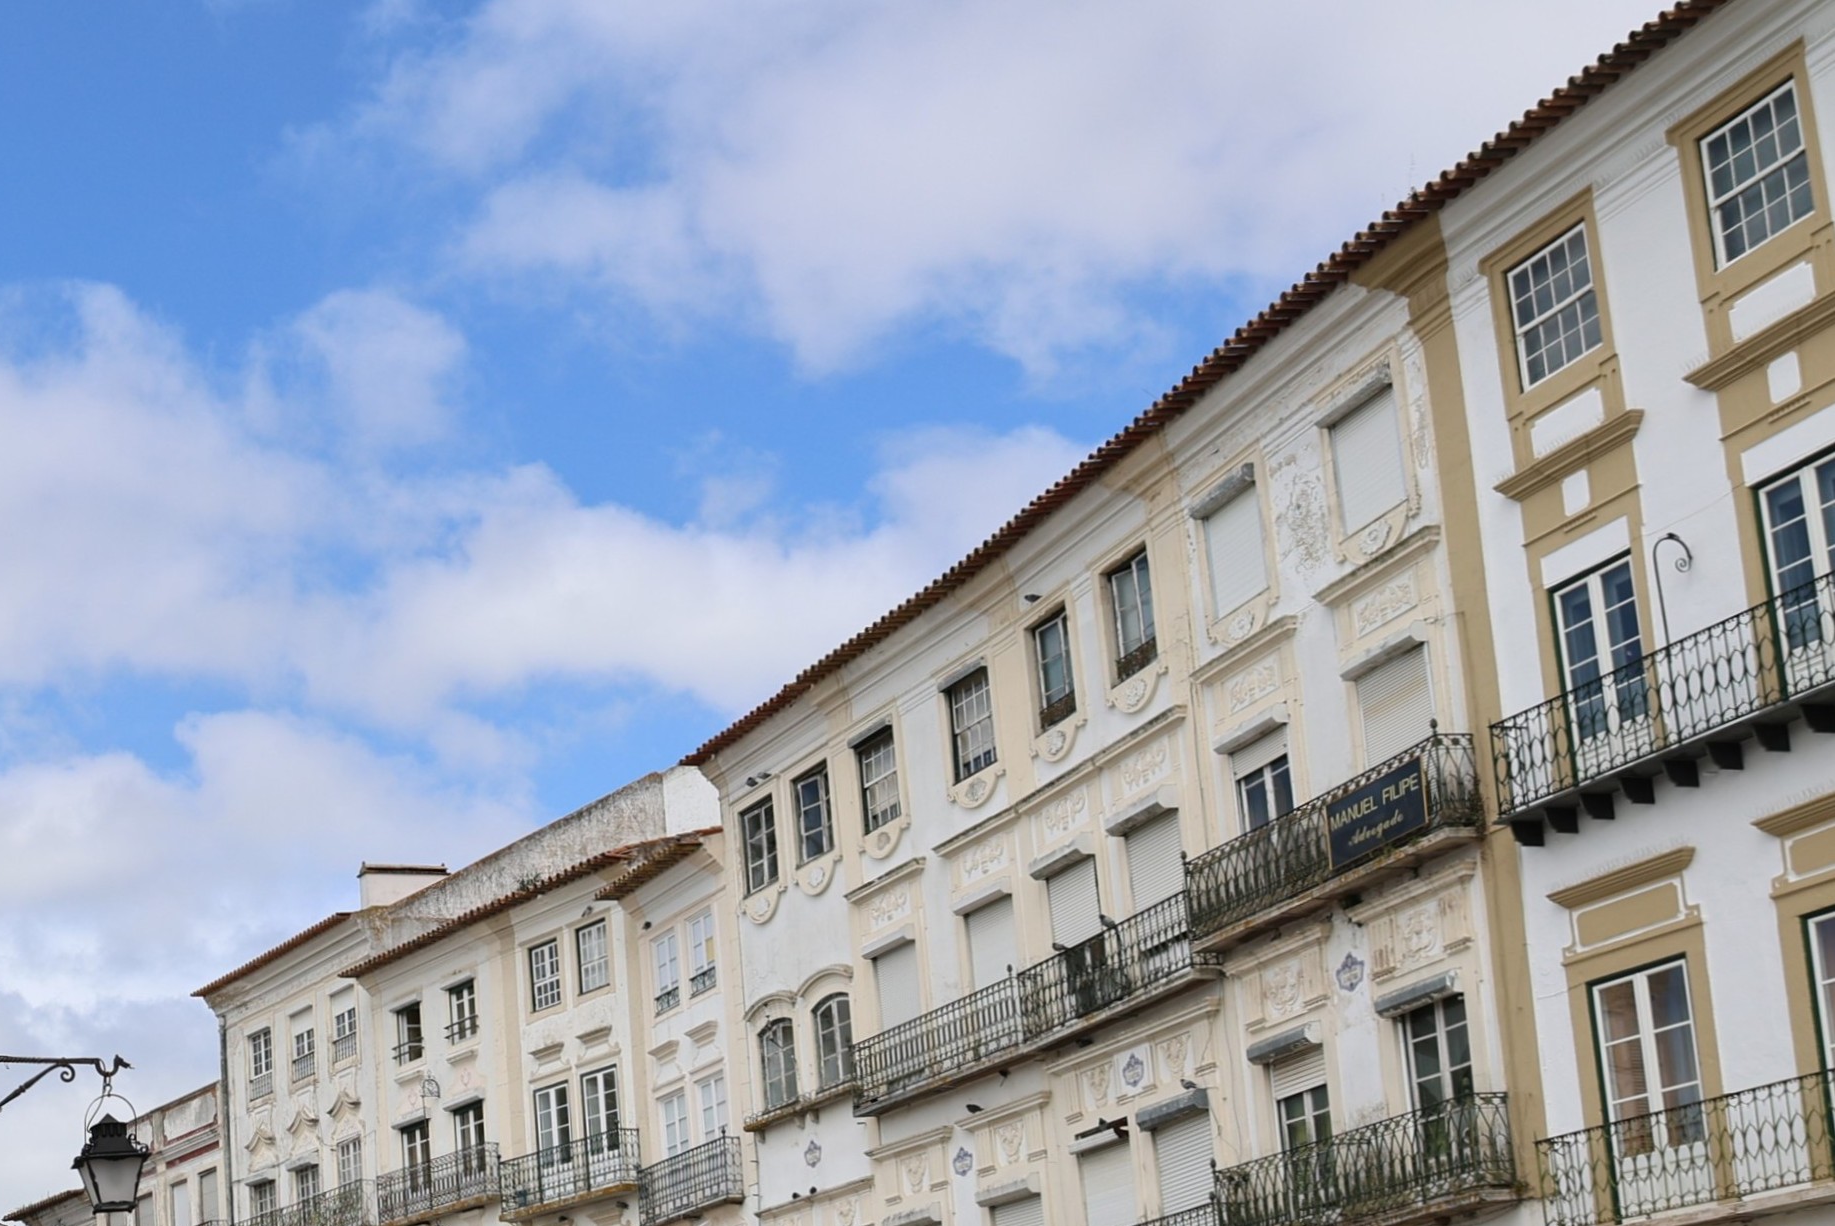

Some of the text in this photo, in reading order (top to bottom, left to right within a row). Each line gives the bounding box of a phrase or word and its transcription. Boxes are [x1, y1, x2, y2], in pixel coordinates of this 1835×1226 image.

[1330, 773, 1419, 831] MANUEL FILIPE
[1348, 809, 1404, 846] Advogado
